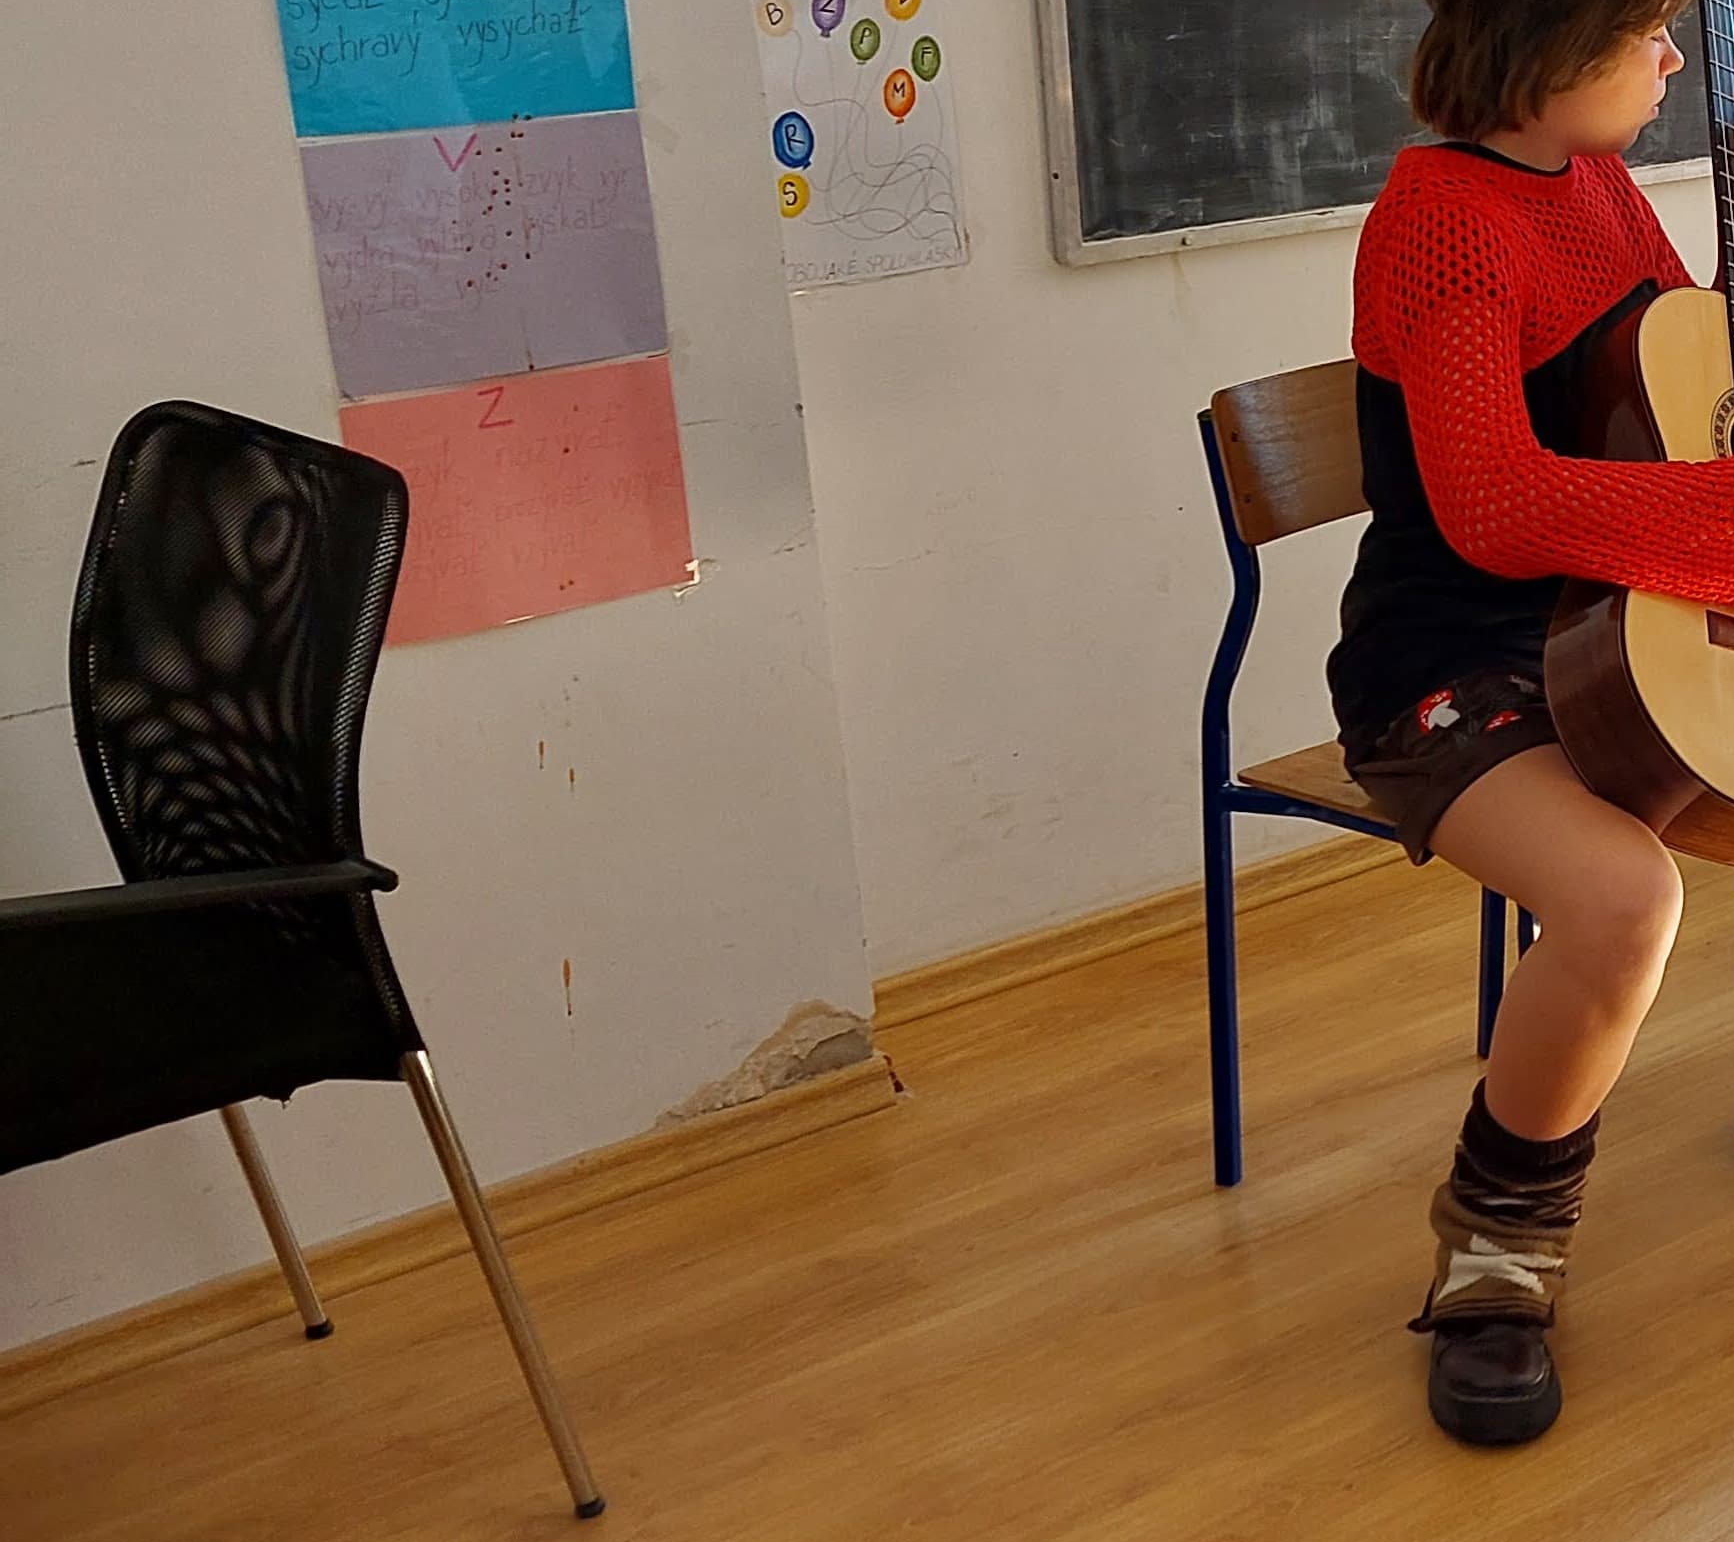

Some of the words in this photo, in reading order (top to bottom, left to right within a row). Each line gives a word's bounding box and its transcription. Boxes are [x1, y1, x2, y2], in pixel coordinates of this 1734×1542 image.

[766, 2, 784, 26] B
[860, 27, 873, 45] P
[291, 10, 421, 90] sychravý
[921, 47, 932, 67] F
[892, 82, 905, 98] M
[785, 123, 805, 151] R
[433, 133, 478, 171] V
[782, 181, 798, 206] S
[477, 385, 513, 430] Z
